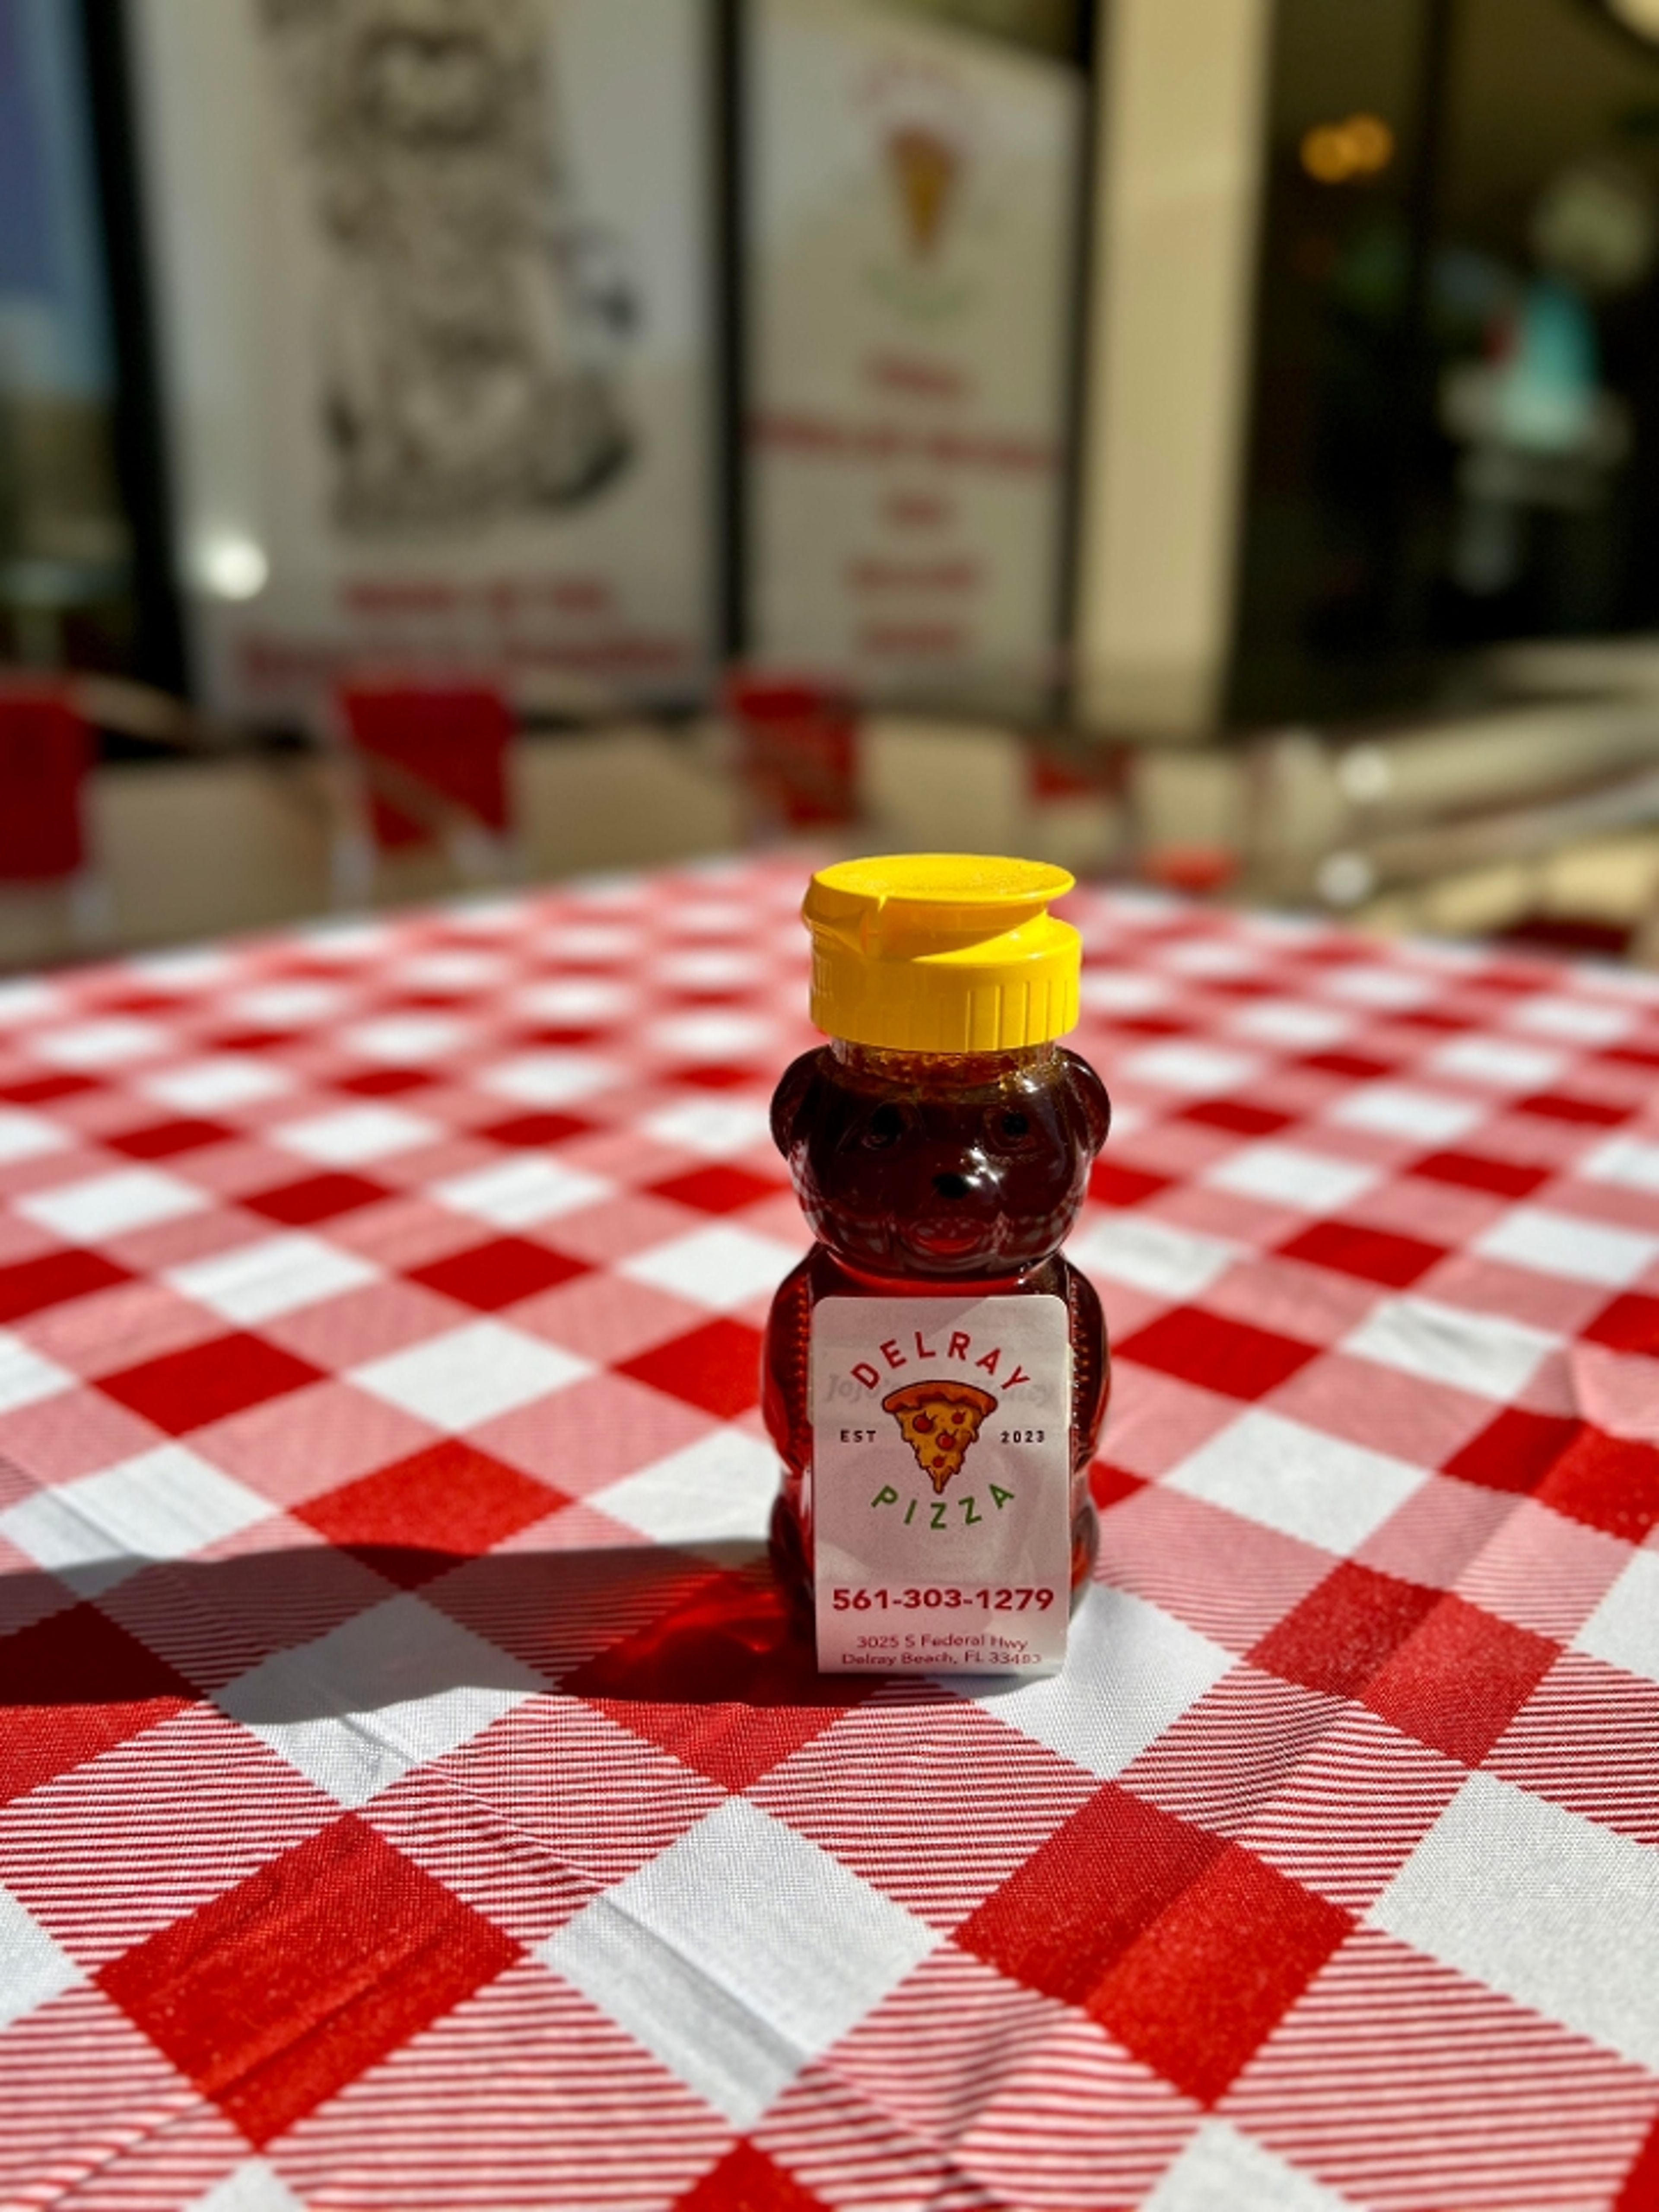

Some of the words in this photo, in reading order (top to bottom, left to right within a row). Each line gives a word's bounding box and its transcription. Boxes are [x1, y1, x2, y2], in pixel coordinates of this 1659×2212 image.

[850, 1331, 1030, 1390] DELRAY
[840, 1430, 877, 1443] EST
[1001, 1430, 1046, 1443] 2023
[871, 1484, 1015, 1529] PIZZA
[832, 1589, 1054, 1611] 561-303-1279
[857, 1635, 899, 1648] 3025
[905, 1635, 916, 1648] S
[921, 1634, 985, 1647] Federal
[990, 1635, 1028, 1652] Hwy
[842, 1653, 897, 1667] Delray
[901, 1652, 957, 1665] Beach,
[965, 1650, 984, 1662] FL
